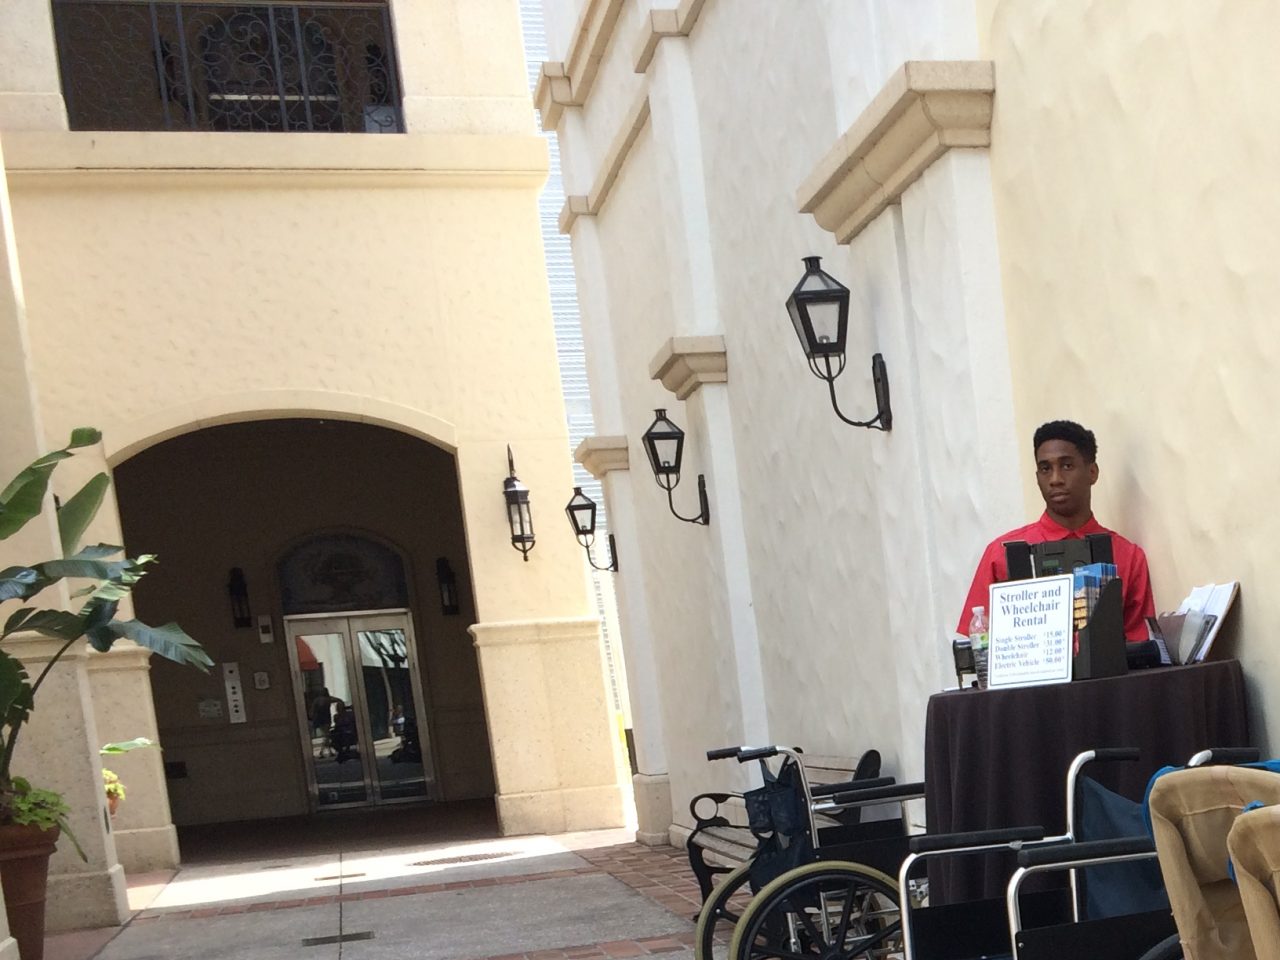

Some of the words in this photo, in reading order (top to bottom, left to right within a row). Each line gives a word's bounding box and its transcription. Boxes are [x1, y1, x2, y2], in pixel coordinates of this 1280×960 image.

[1000, 590, 1039, 604] Stroller
[1042, 585, 1061, 597] and
[1001, 600, 1060, 615] Wheelchair
[1013, 614, 1047, 628] Rental
[1014, 633, 1037, 642] Stroller
[1017, 641, 1040, 650] Stroller
[995, 652, 1029, 661] Wheelchair
